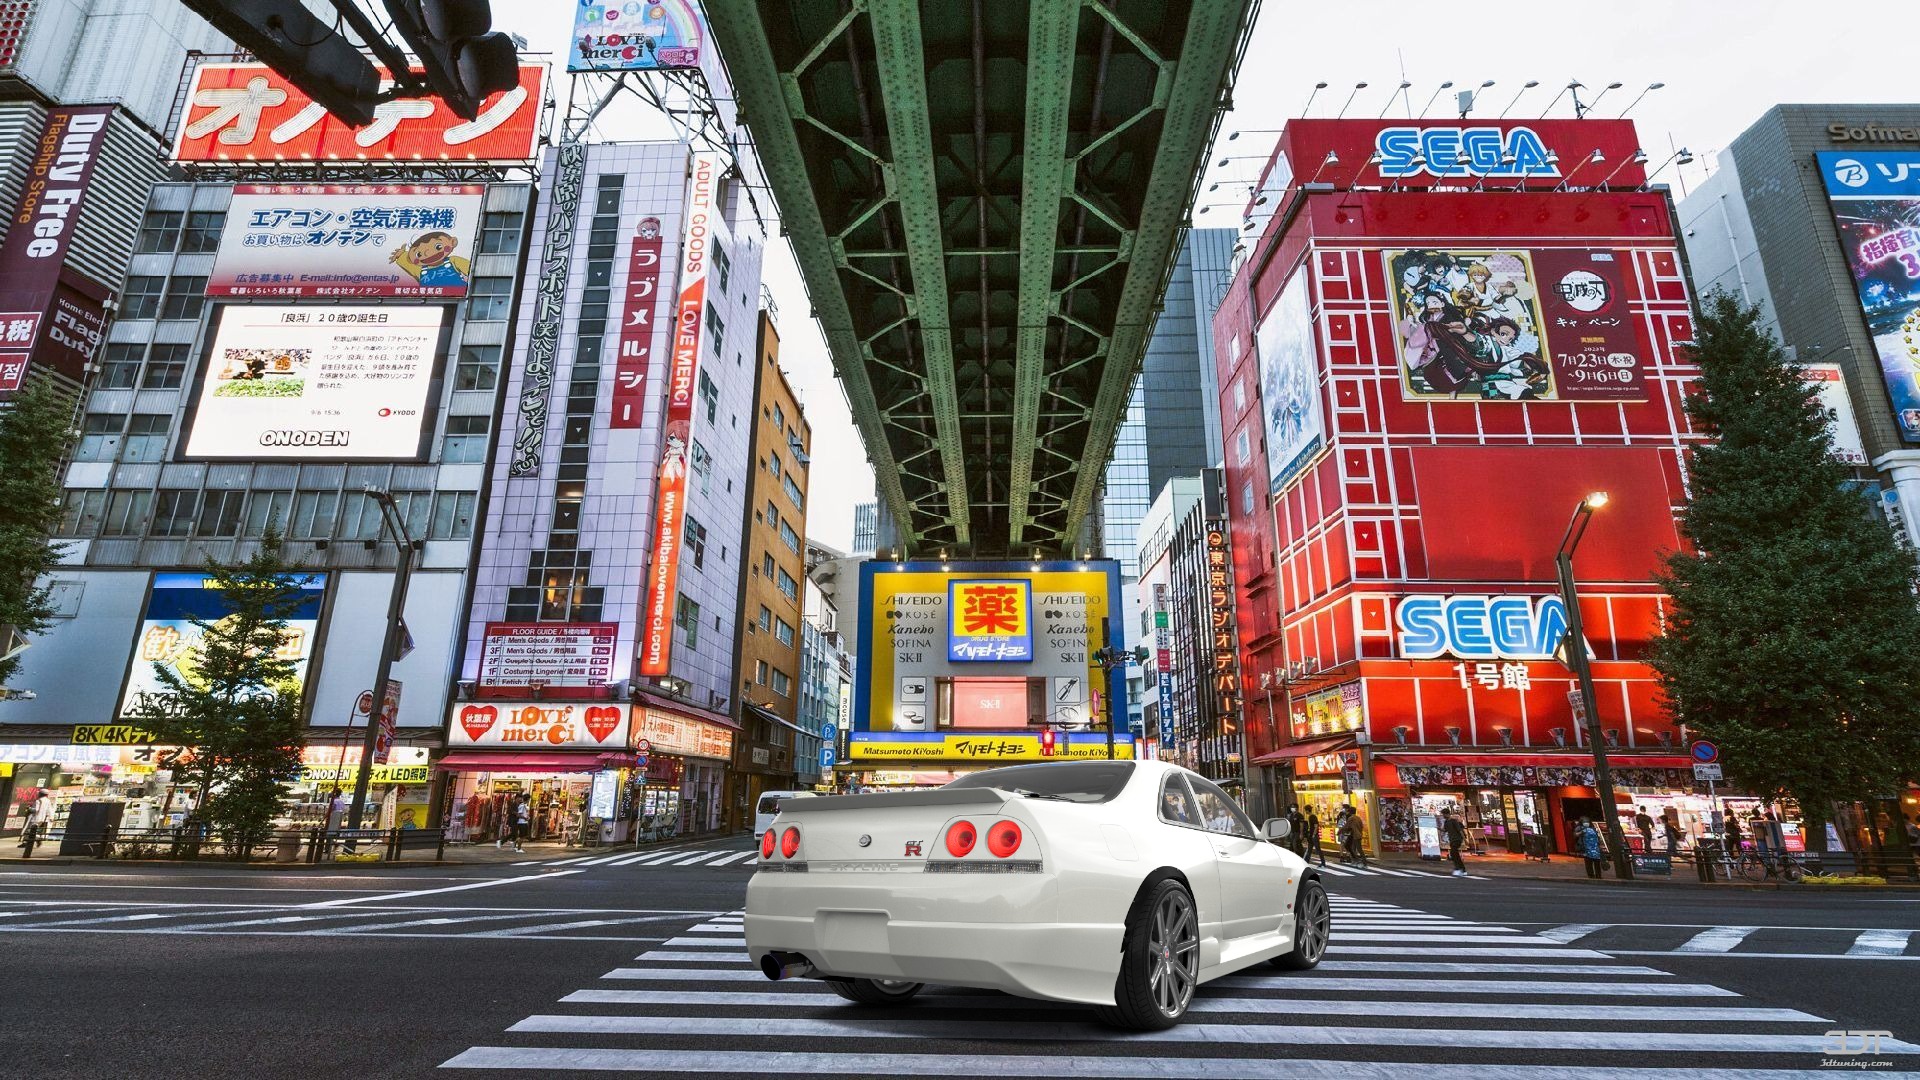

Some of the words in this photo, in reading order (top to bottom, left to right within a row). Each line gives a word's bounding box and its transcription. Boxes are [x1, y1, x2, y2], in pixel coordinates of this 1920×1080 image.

[597, 34, 645, 47] LOVE
[33, 114, 67, 177] Flagship
[48, 114, 107, 182] Duty
[1377, 127, 1562, 177] SEGA
[694, 159, 712, 209] ADULT
[19, 180, 45, 224] Store
[27, 189, 82, 258] Free
[248, 206, 457, 230] エアコン・空気清浄機
[686, 213, 707, 273] GOODS
[235, 274, 294, 283] 広告募集中
[316, 287, 381, 295] 株式会社オノデン
[59, 298, 84, 315] Home
[680, 299, 698, 346] LOVE
[49, 326, 96, 358] Duty
[619, 249, 659, 421] ラブメルシー
[673, 349, 693, 408] MERCI
[259, 430, 350, 447] ONODEN
[649, 491, 675, 665] www.akibalovemerci.com
[881, 596, 942, 605] SHISEIDO
[1039, 595, 1101, 605] SHISEIDO
[963, 586, 1019, 634] 薬
[888, 624, 934, 634] Kanebo
[1046, 624, 1095, 634] Kanebo
[1396, 595, 1596, 660] SEGA
[490, 647, 500, 655] 3F
[890, 639, 932, 648] SOFINA
[953, 642, 1027, 660] マツモトキヨシ
[1050, 639, 1093, 648] SOFINA
[1209, 550, 1236, 735] 東京ラジオデパート
[899, 653, 922, 662] SK-II
[1061, 653, 1084, 662] SK-II
[1453, 663, 1530, 691] 1号館
[465, 713, 492, 723] 秋葉原
[510, 706, 569, 726] LOVE
[75, 726, 101, 744] 8K
[104, 726, 131, 744] 4K
[823, 750, 832, 765] P
[863, 747, 912, 756] Matsumoto
[913, 747, 944, 756] KiYoshi
[955, 740, 1026, 757] マツモトキヨシ
[829, 863, 899, 872] SKYLINE
